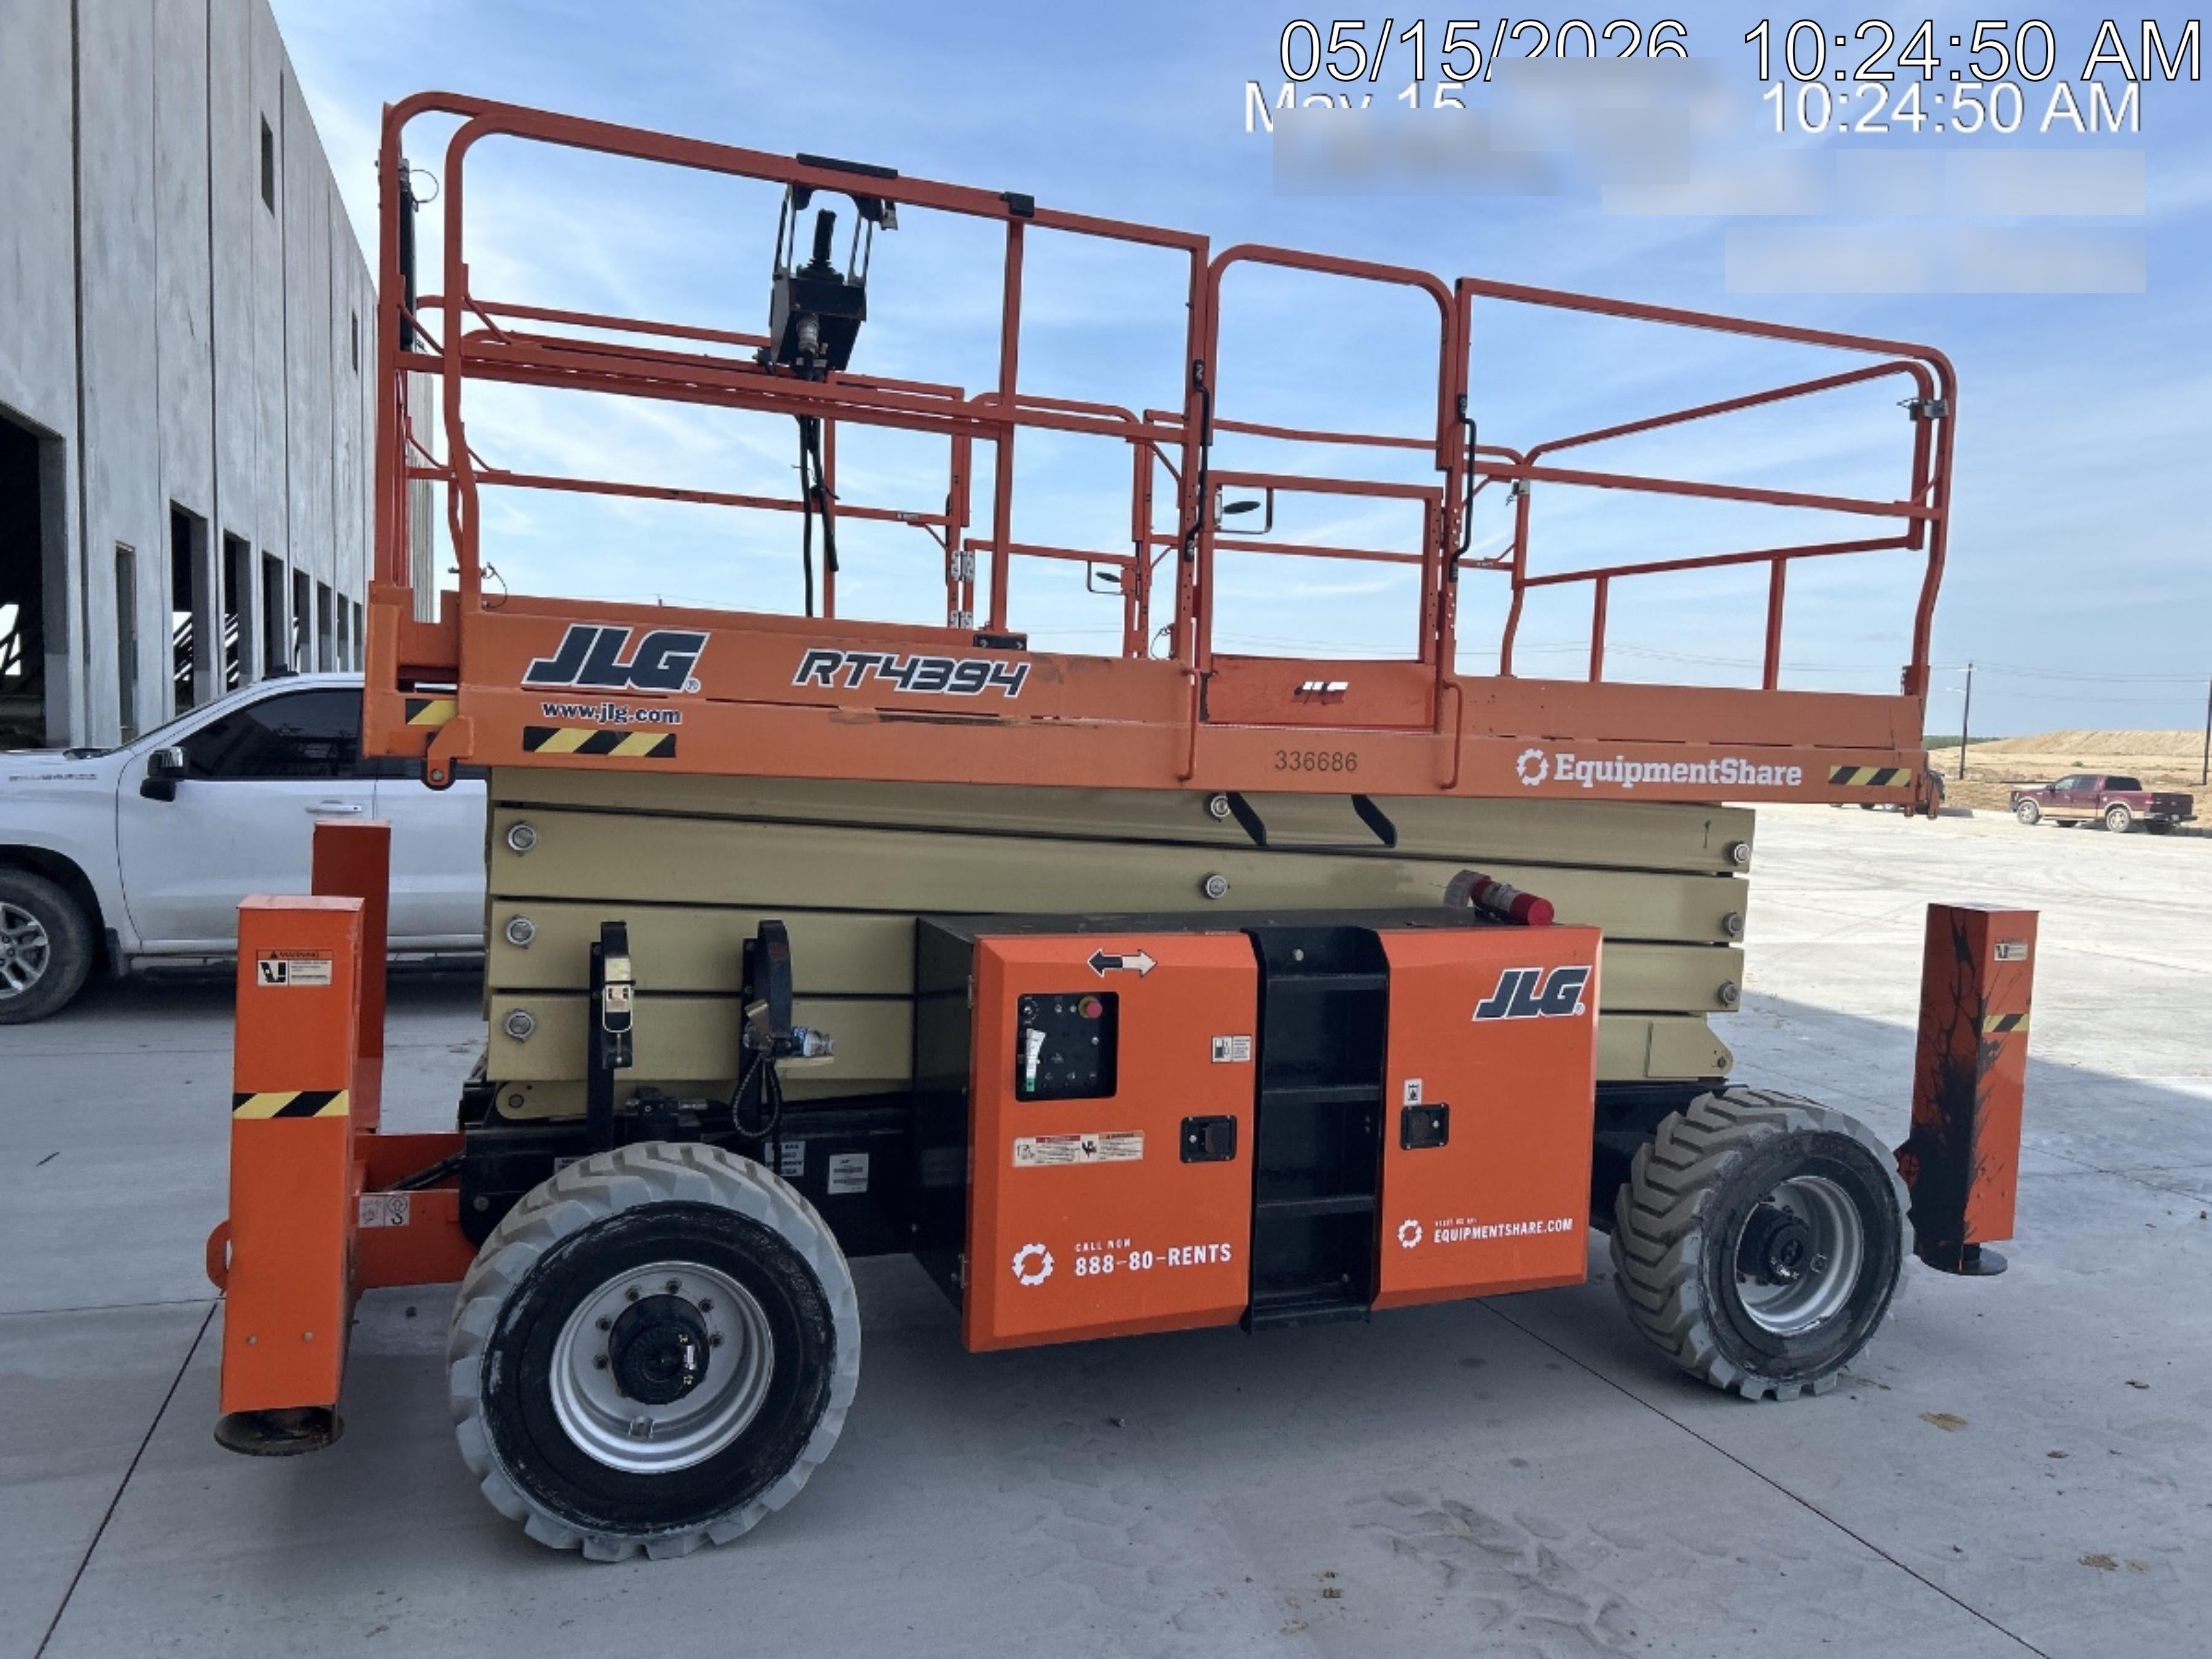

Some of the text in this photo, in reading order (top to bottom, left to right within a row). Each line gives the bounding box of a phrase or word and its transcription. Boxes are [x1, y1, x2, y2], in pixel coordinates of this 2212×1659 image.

[521, 624, 710, 693] JLG
[792, 648, 1031, 697] RT4394
[542, 702, 682, 724] www.jlg.com
[1275, 750, 1357, 772] 336686
[1554, 753, 1802, 788] EquipmentShare
[1472, 965, 1593, 1022] JLG
[1433, 1218, 1574, 1243] EQUIPMENTSHARE.COM
[1075, 1243, 1232, 1277] 888-80-RENTS
